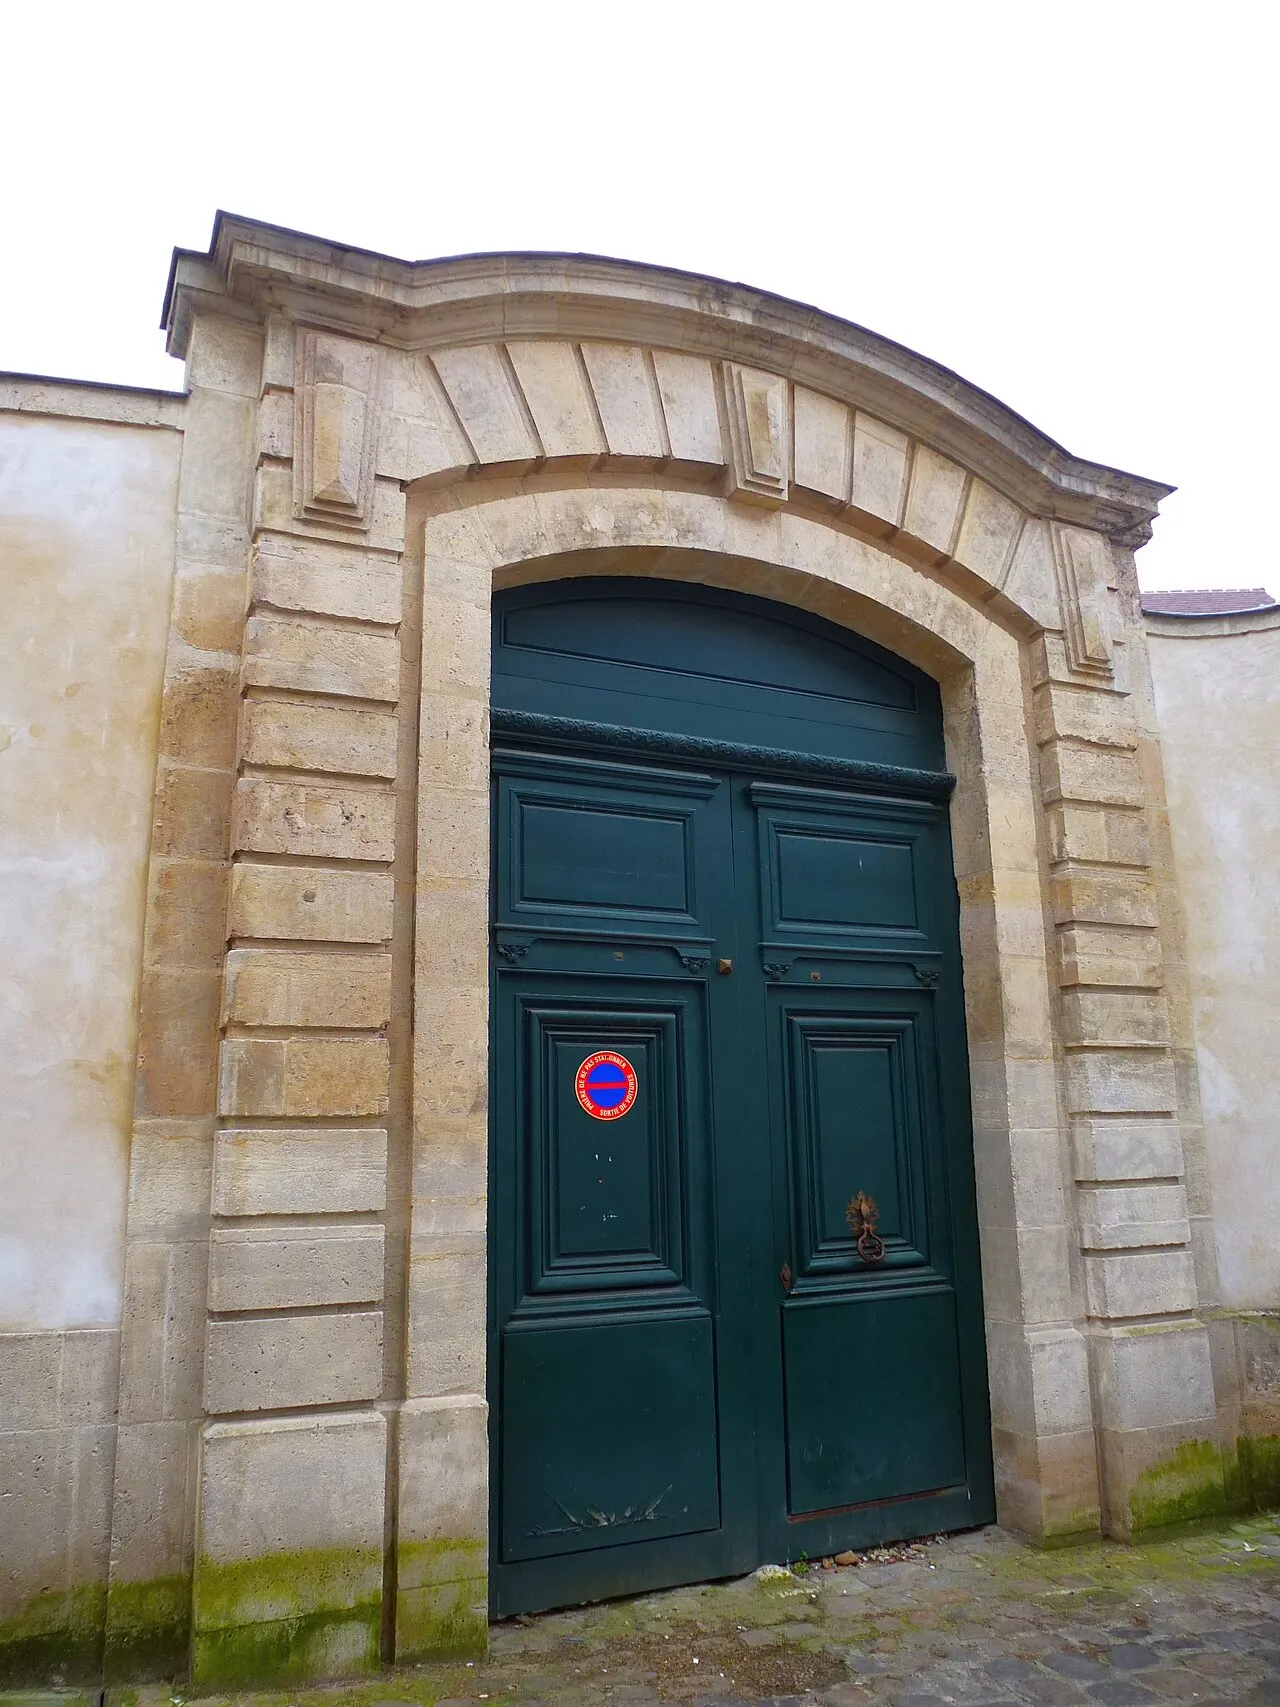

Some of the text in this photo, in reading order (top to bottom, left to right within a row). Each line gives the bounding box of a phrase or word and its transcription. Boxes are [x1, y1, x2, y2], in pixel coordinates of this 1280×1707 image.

[584, 1059, 594, 1070] PAS
[580, 1070, 587, 1079] NE
[578, 1080, 585, 1088] DE
[600, 1074, 635, 1116] SORTIE DE VOITURES
